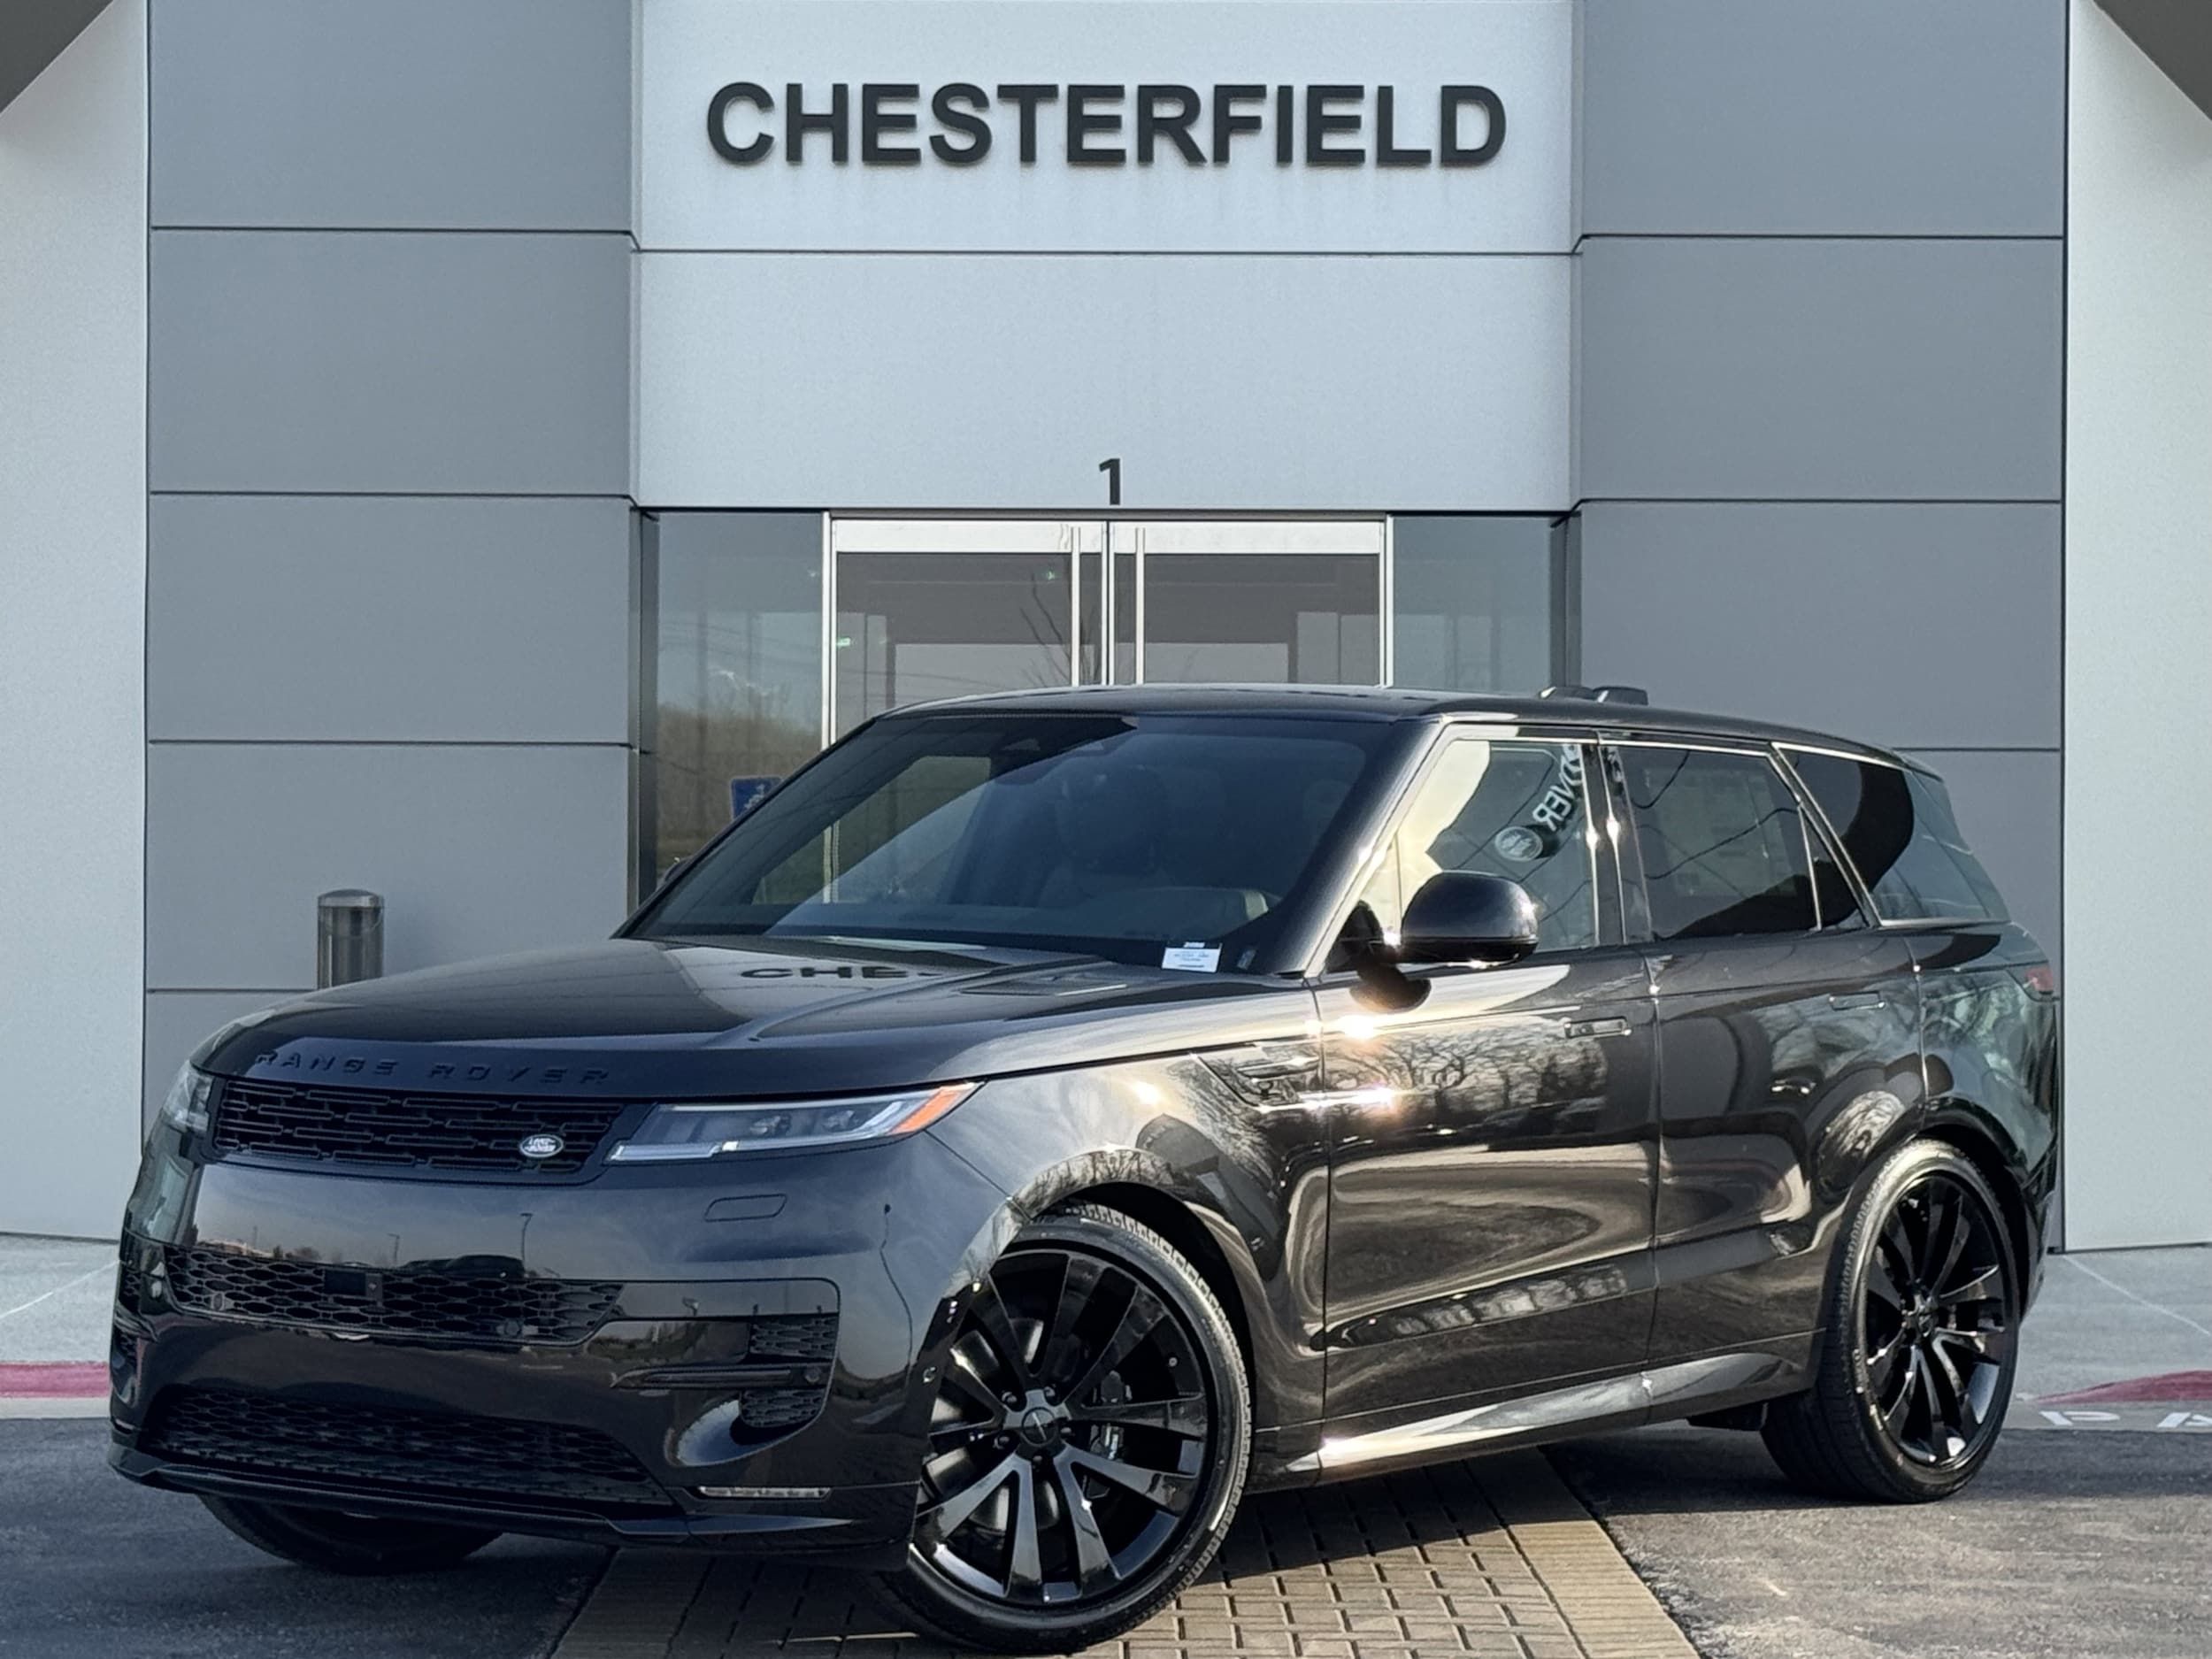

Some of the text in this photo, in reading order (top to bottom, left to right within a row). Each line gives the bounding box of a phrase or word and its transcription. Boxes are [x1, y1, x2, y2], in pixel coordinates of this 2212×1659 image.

[706, 81, 1508, 166] CHESTERFIELD
[1098, 457, 1121, 506] 1
[254, 1049, 610, 1085] RANGE ROVER
